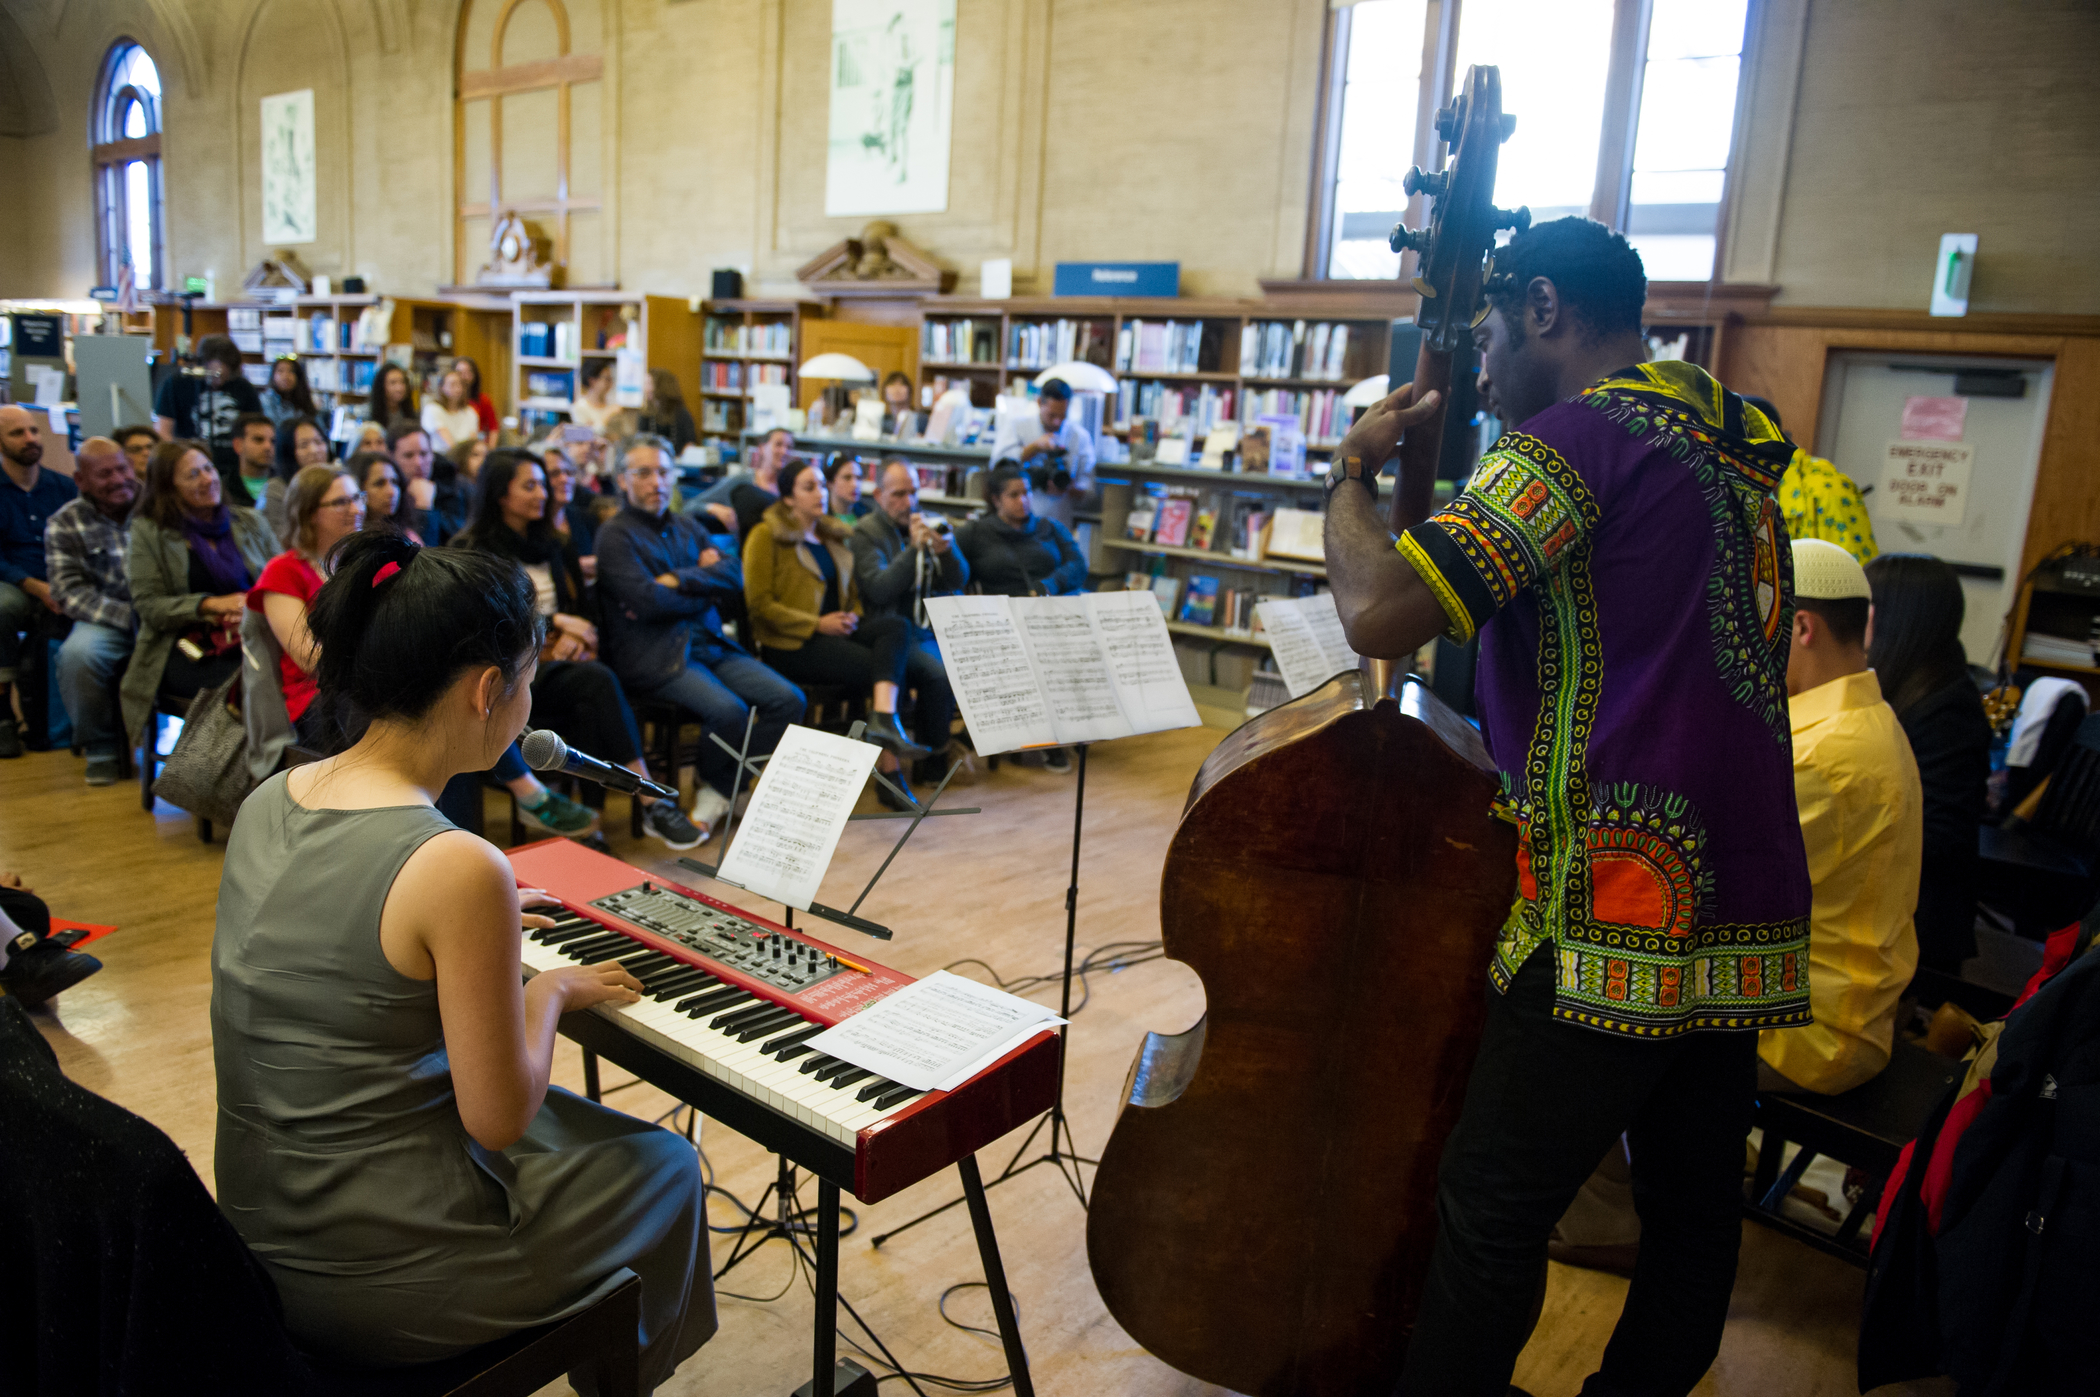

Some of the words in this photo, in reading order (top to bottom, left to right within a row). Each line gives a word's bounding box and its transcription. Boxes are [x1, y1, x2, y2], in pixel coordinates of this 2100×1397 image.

[1890, 447, 1968, 461] EMERGENCY
[1908, 463, 1944, 477] EXIT
[1890, 480, 1927, 493] DOOR
[1938, 485, 1957, 496] ON
[1899, 495, 1944, 508] ALARM
